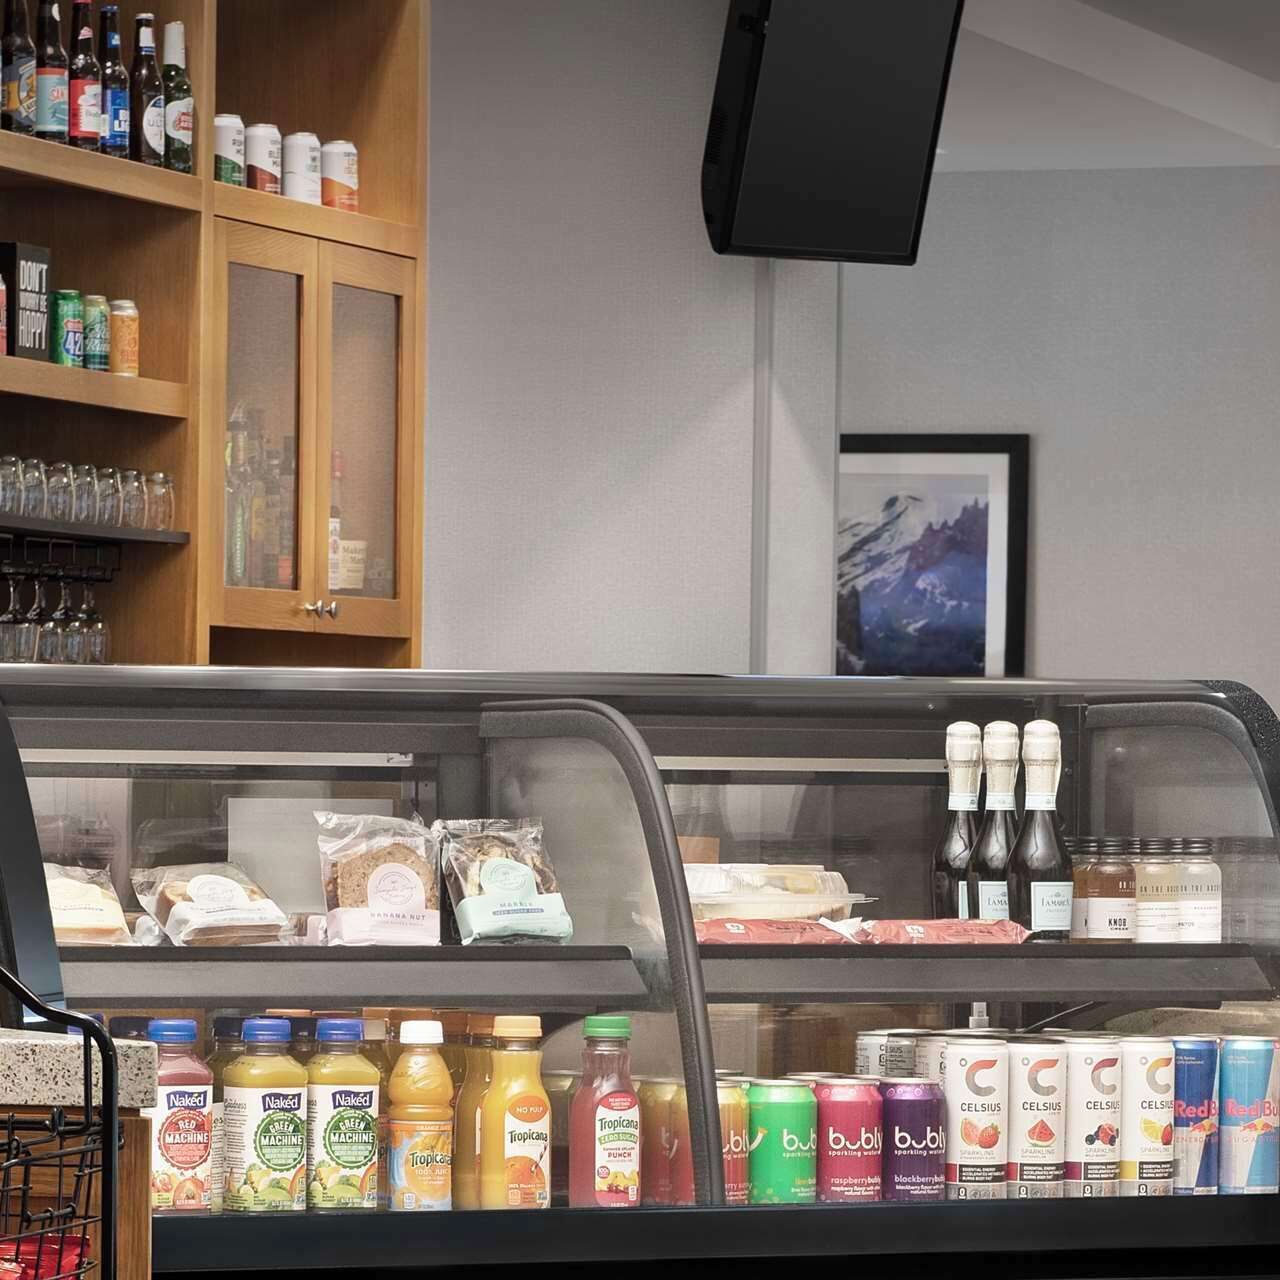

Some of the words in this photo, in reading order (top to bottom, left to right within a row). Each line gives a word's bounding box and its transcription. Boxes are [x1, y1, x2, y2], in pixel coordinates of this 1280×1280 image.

[20, 260, 48, 293] DON'T
[19, 310, 48, 350] HOPPY
[1108, 918, 1127, 927] KNOB
[516, 1106, 528, 1114] NO
[530, 1106, 544, 1114] PULP
[960, 1102, 1001, 1112] CELSIUS
[1022, 1101, 1062, 1111] CELSIUS
[178, 1120, 195, 1130] RED
[269, 1122, 295, 1134] GREEN
[338, 1119, 366, 1131] GREEN
[598, 1115, 639, 1132] Tropicana
[165, 1133, 209, 1145] MACHINE
[260, 1134, 304, 1147] MACHINE
[329, 1132, 375, 1144] MACHINE
[508, 1128, 548, 1143] Tropicana
[600, 1134, 618, 1144] ZERO
[782, 1129, 817, 1150] bub
[894, 1149, 927, 1157] sparkling
